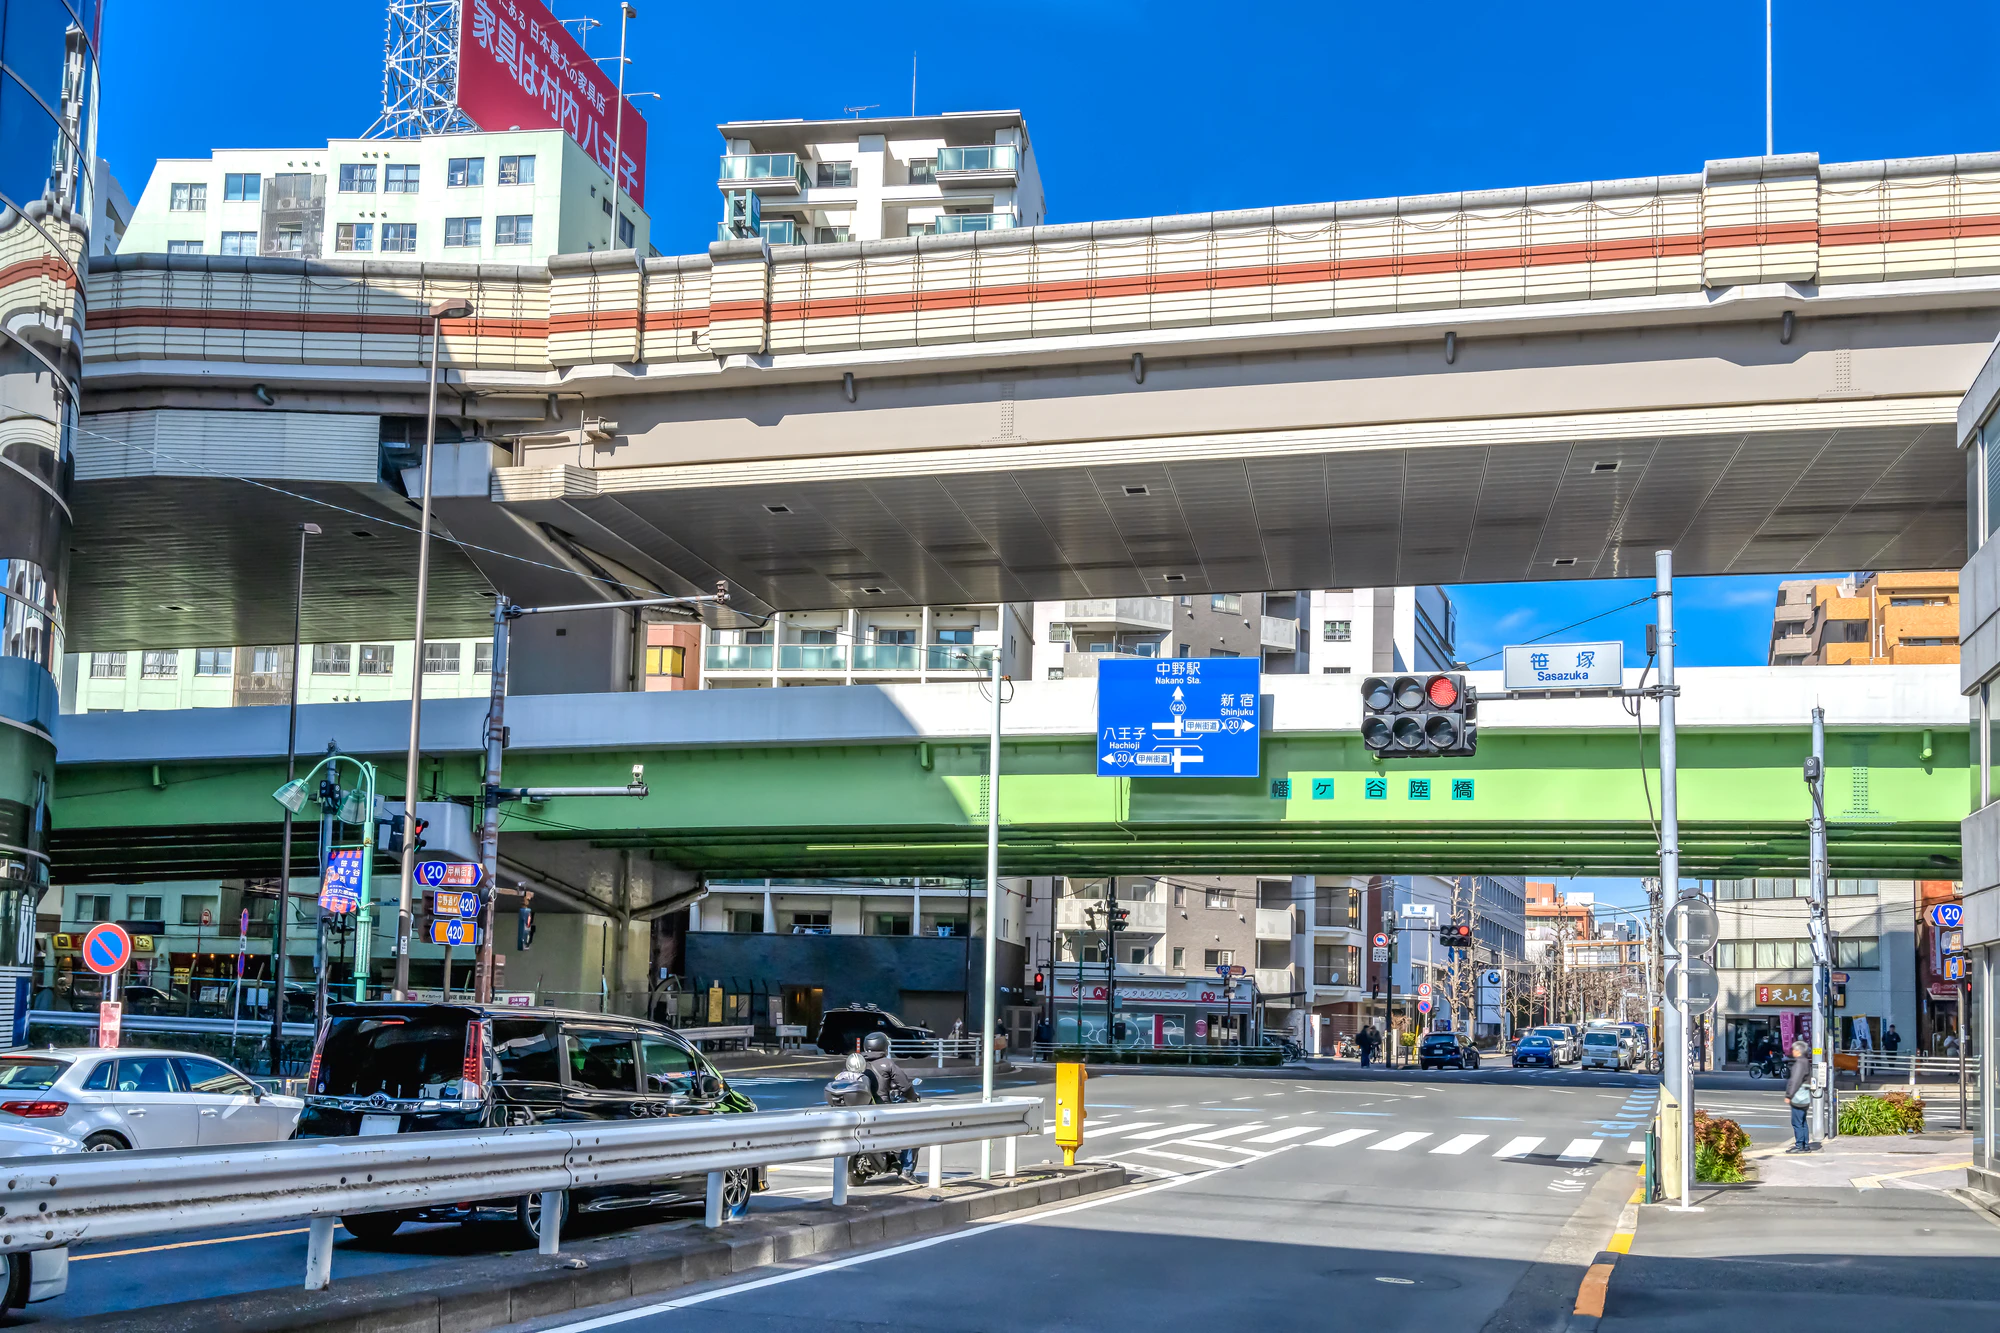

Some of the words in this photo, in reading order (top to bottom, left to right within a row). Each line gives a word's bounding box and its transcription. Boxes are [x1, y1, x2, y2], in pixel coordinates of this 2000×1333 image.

[530, 18, 607, 117] 日本最大の家具店
[1530, 651, 1596, 671] 笹塚
[1156, 661, 1201, 676] 中野駅
[1155, 676, 1184, 685] Nakano
[1187, 676, 1202, 685] Sta.
[1537, 670, 1589, 682] Sasazuka
[1220, 693, 1255, 707] 新宿
[1171, 704, 1184, 712] 420
[1220, 708, 1254, 717] Shinjuku
[1187, 721, 1217, 730] 甲州街道
[1228, 720, 1239, 729] 20
[1103, 727, 1146, 741] 八王子
[1109, 741, 1140, 750] Hachioji
[1117, 753, 1128, 763] 20
[1138, 755, 1168, 764] 甲州街道
[427, 865, 444, 879] 20
[460, 898, 475, 912] 420
[1944, 907, 1960, 921] 20
[447, 925, 462, 940] 420
[1115, 989, 1188, 999] デンタルクリニック
